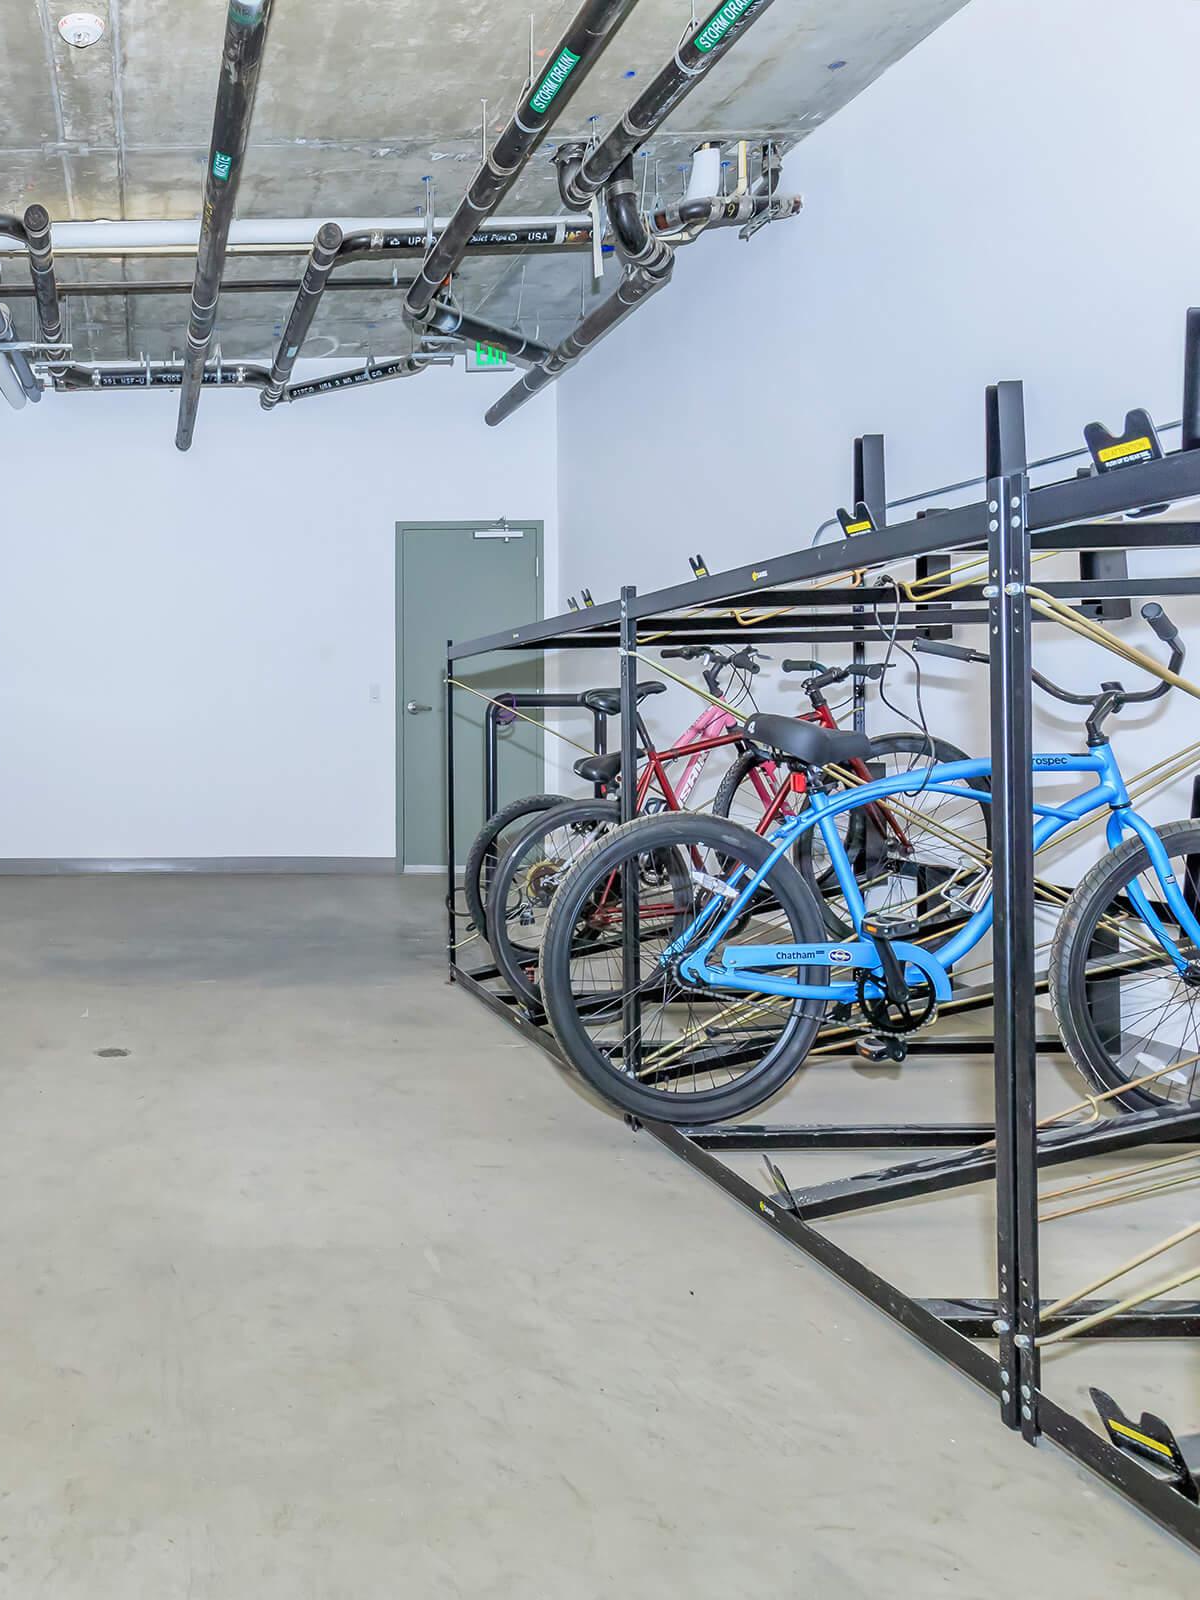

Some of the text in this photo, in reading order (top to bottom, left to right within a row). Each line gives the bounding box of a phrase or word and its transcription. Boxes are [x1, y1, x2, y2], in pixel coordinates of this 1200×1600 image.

[699, 15, 730, 48] STORM
[723, 0, 752, 19] DRA
[533, 53, 575, 109] STORM DRAIN
[527, 231, 548, 240] USA
[776, 951, 816, 960] Chatham
